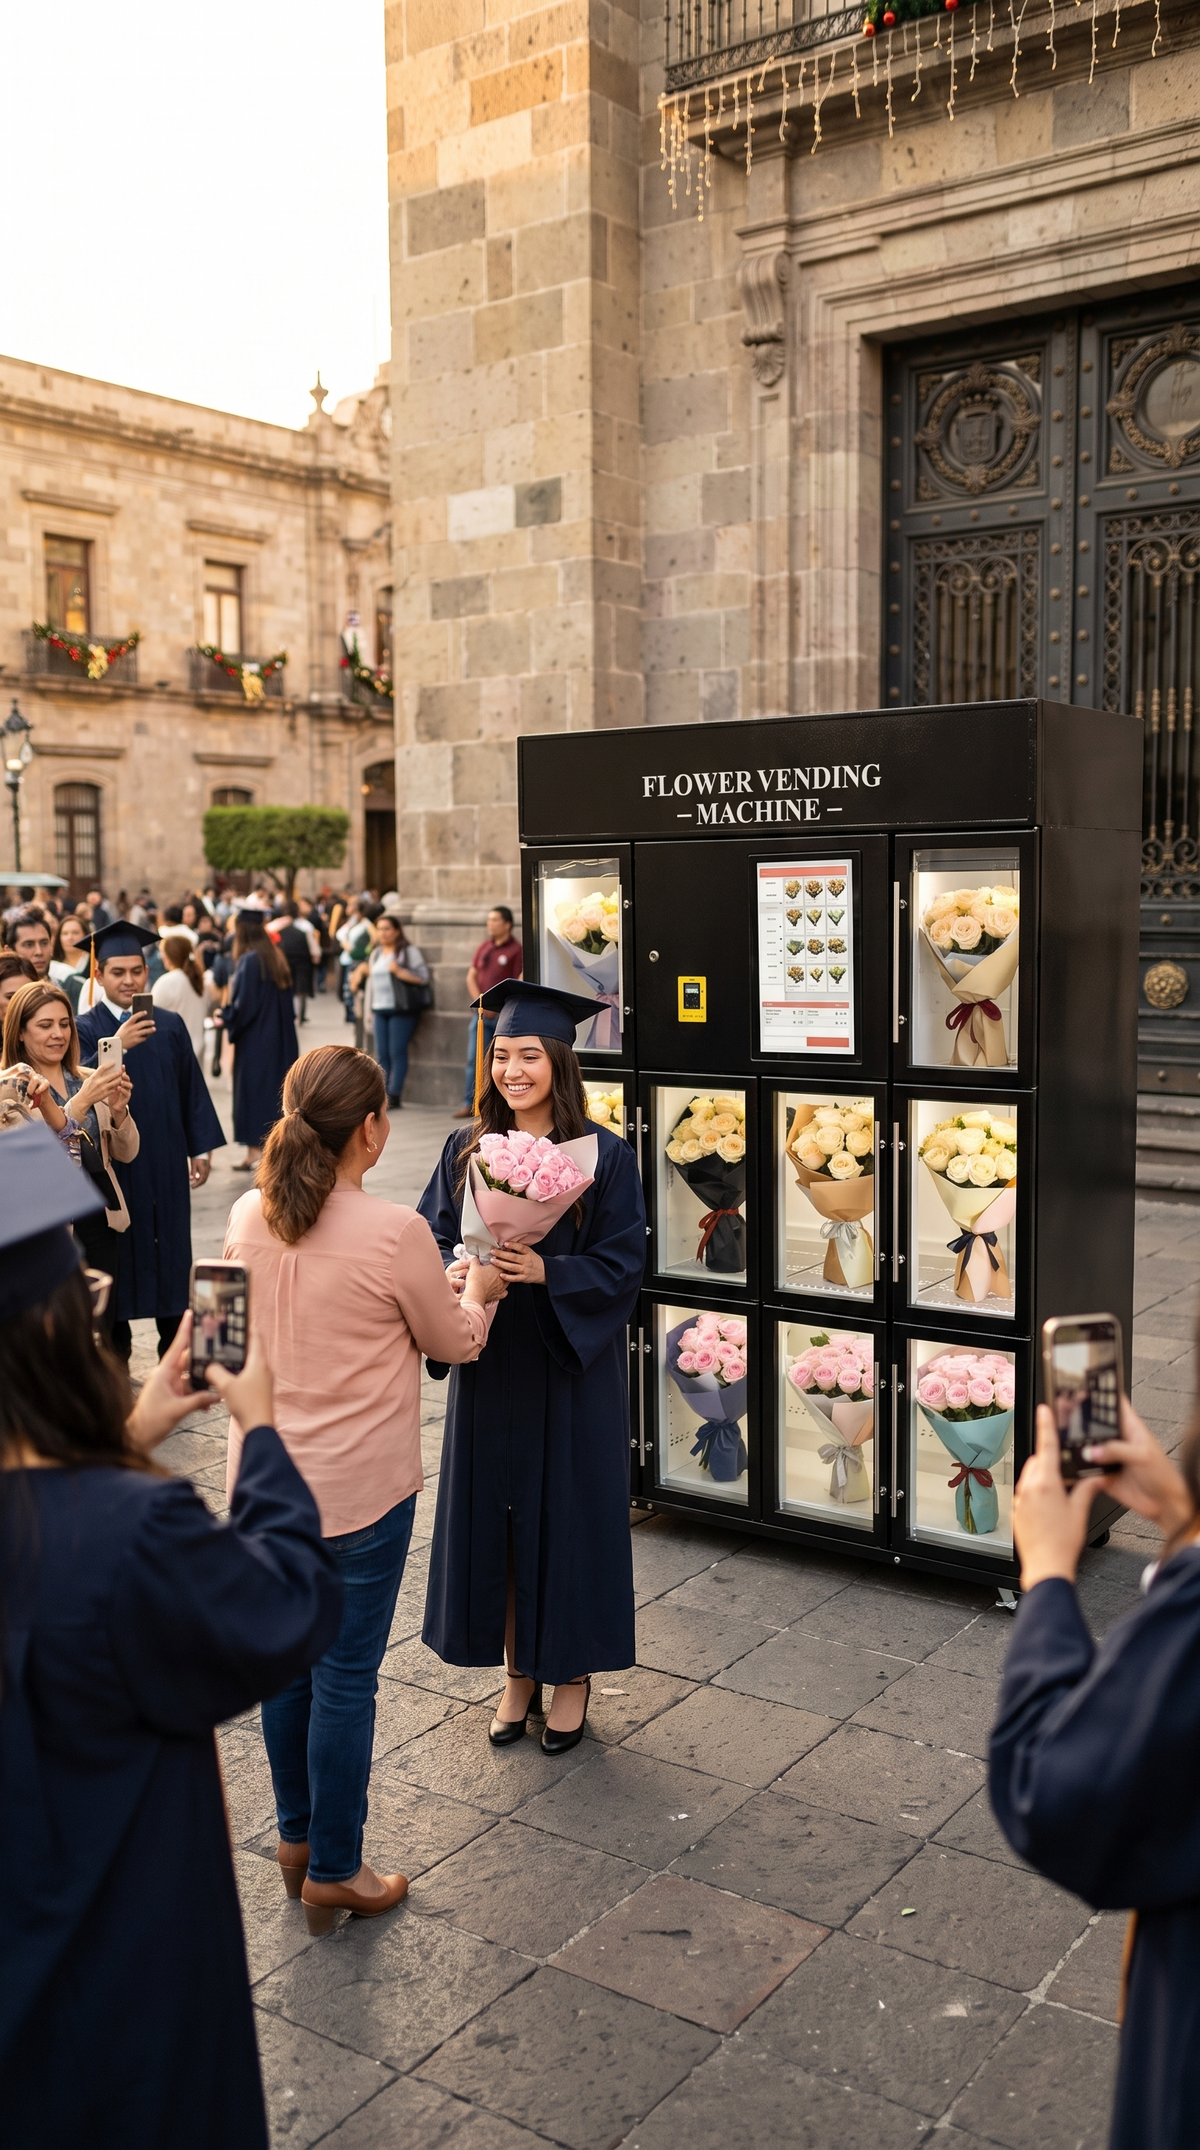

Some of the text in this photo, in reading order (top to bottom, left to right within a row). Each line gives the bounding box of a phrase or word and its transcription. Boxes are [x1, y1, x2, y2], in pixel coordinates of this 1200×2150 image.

[642, 763, 883, 798] FLOWER VENDING
[696, 798, 821, 825] MACHINE
